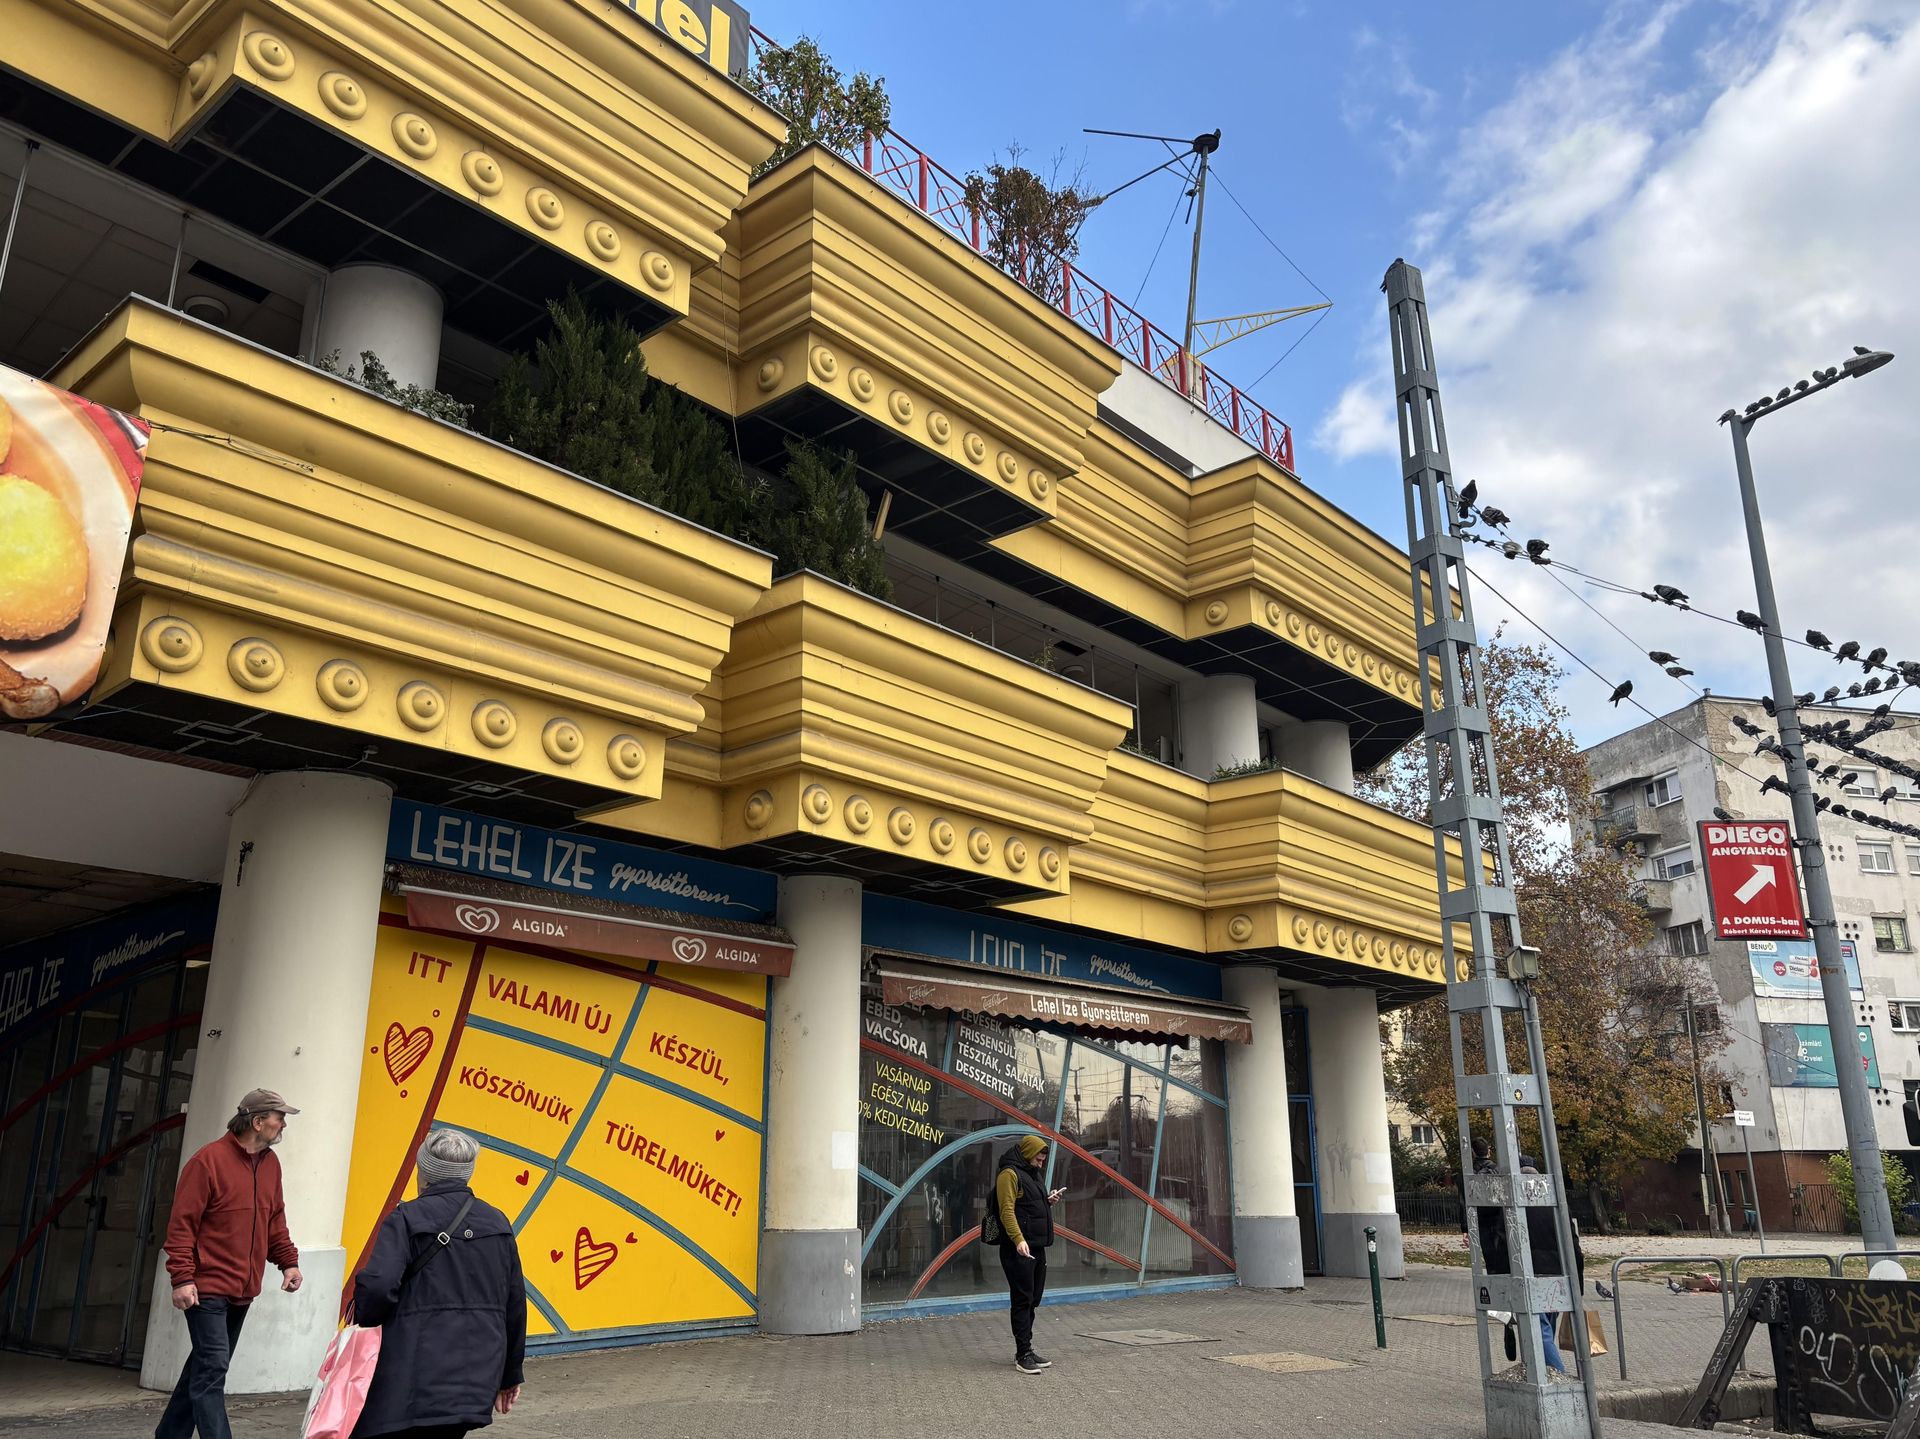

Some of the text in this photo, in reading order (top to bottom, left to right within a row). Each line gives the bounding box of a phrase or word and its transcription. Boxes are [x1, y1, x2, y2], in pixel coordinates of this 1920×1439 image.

[625, 0, 731, 76] el
[1708, 827, 1785, 844] DIEGO
[1712, 845, 1787, 857] ANGYALFÖLD
[410, 810, 532, 879] LEHEL
[608, 862, 760, 911] gyorsétterem
[512, 918, 565, 937] ALGIDA
[1722, 917, 1731, 925] A
[1750, 928, 1771, 936] Károly
[408, 952, 452, 983] ITT
[715, 947, 758, 964] ALGIDA
[1090, 954, 1170, 994] gyorsétterem
[488, 974, 613, 1035] VALAMI ÚJ
[1030, 995, 1060, 1015] Lehel
[1081, 1002, 1150, 1025] Gyorsétterem
[865, 1018, 928, 1059] VACSORA
[649, 1031, 729, 1086] KÉSZÜL,
[958, 1042, 1002, 1074] TÉSZTÁK,
[875, 1061, 932, 1095] VASÁRNAP
[956, 1059, 1015, 1099] DESSZERTEK
[458, 1066, 574, 1125] KÖSZÖNJÜK
[871, 1083, 929, 1116] EGÉSZ NAP
[874, 1107, 944, 1145] KEDVEZMÉNY
[604, 1120, 743, 1217] TÜRELMÜKET!
